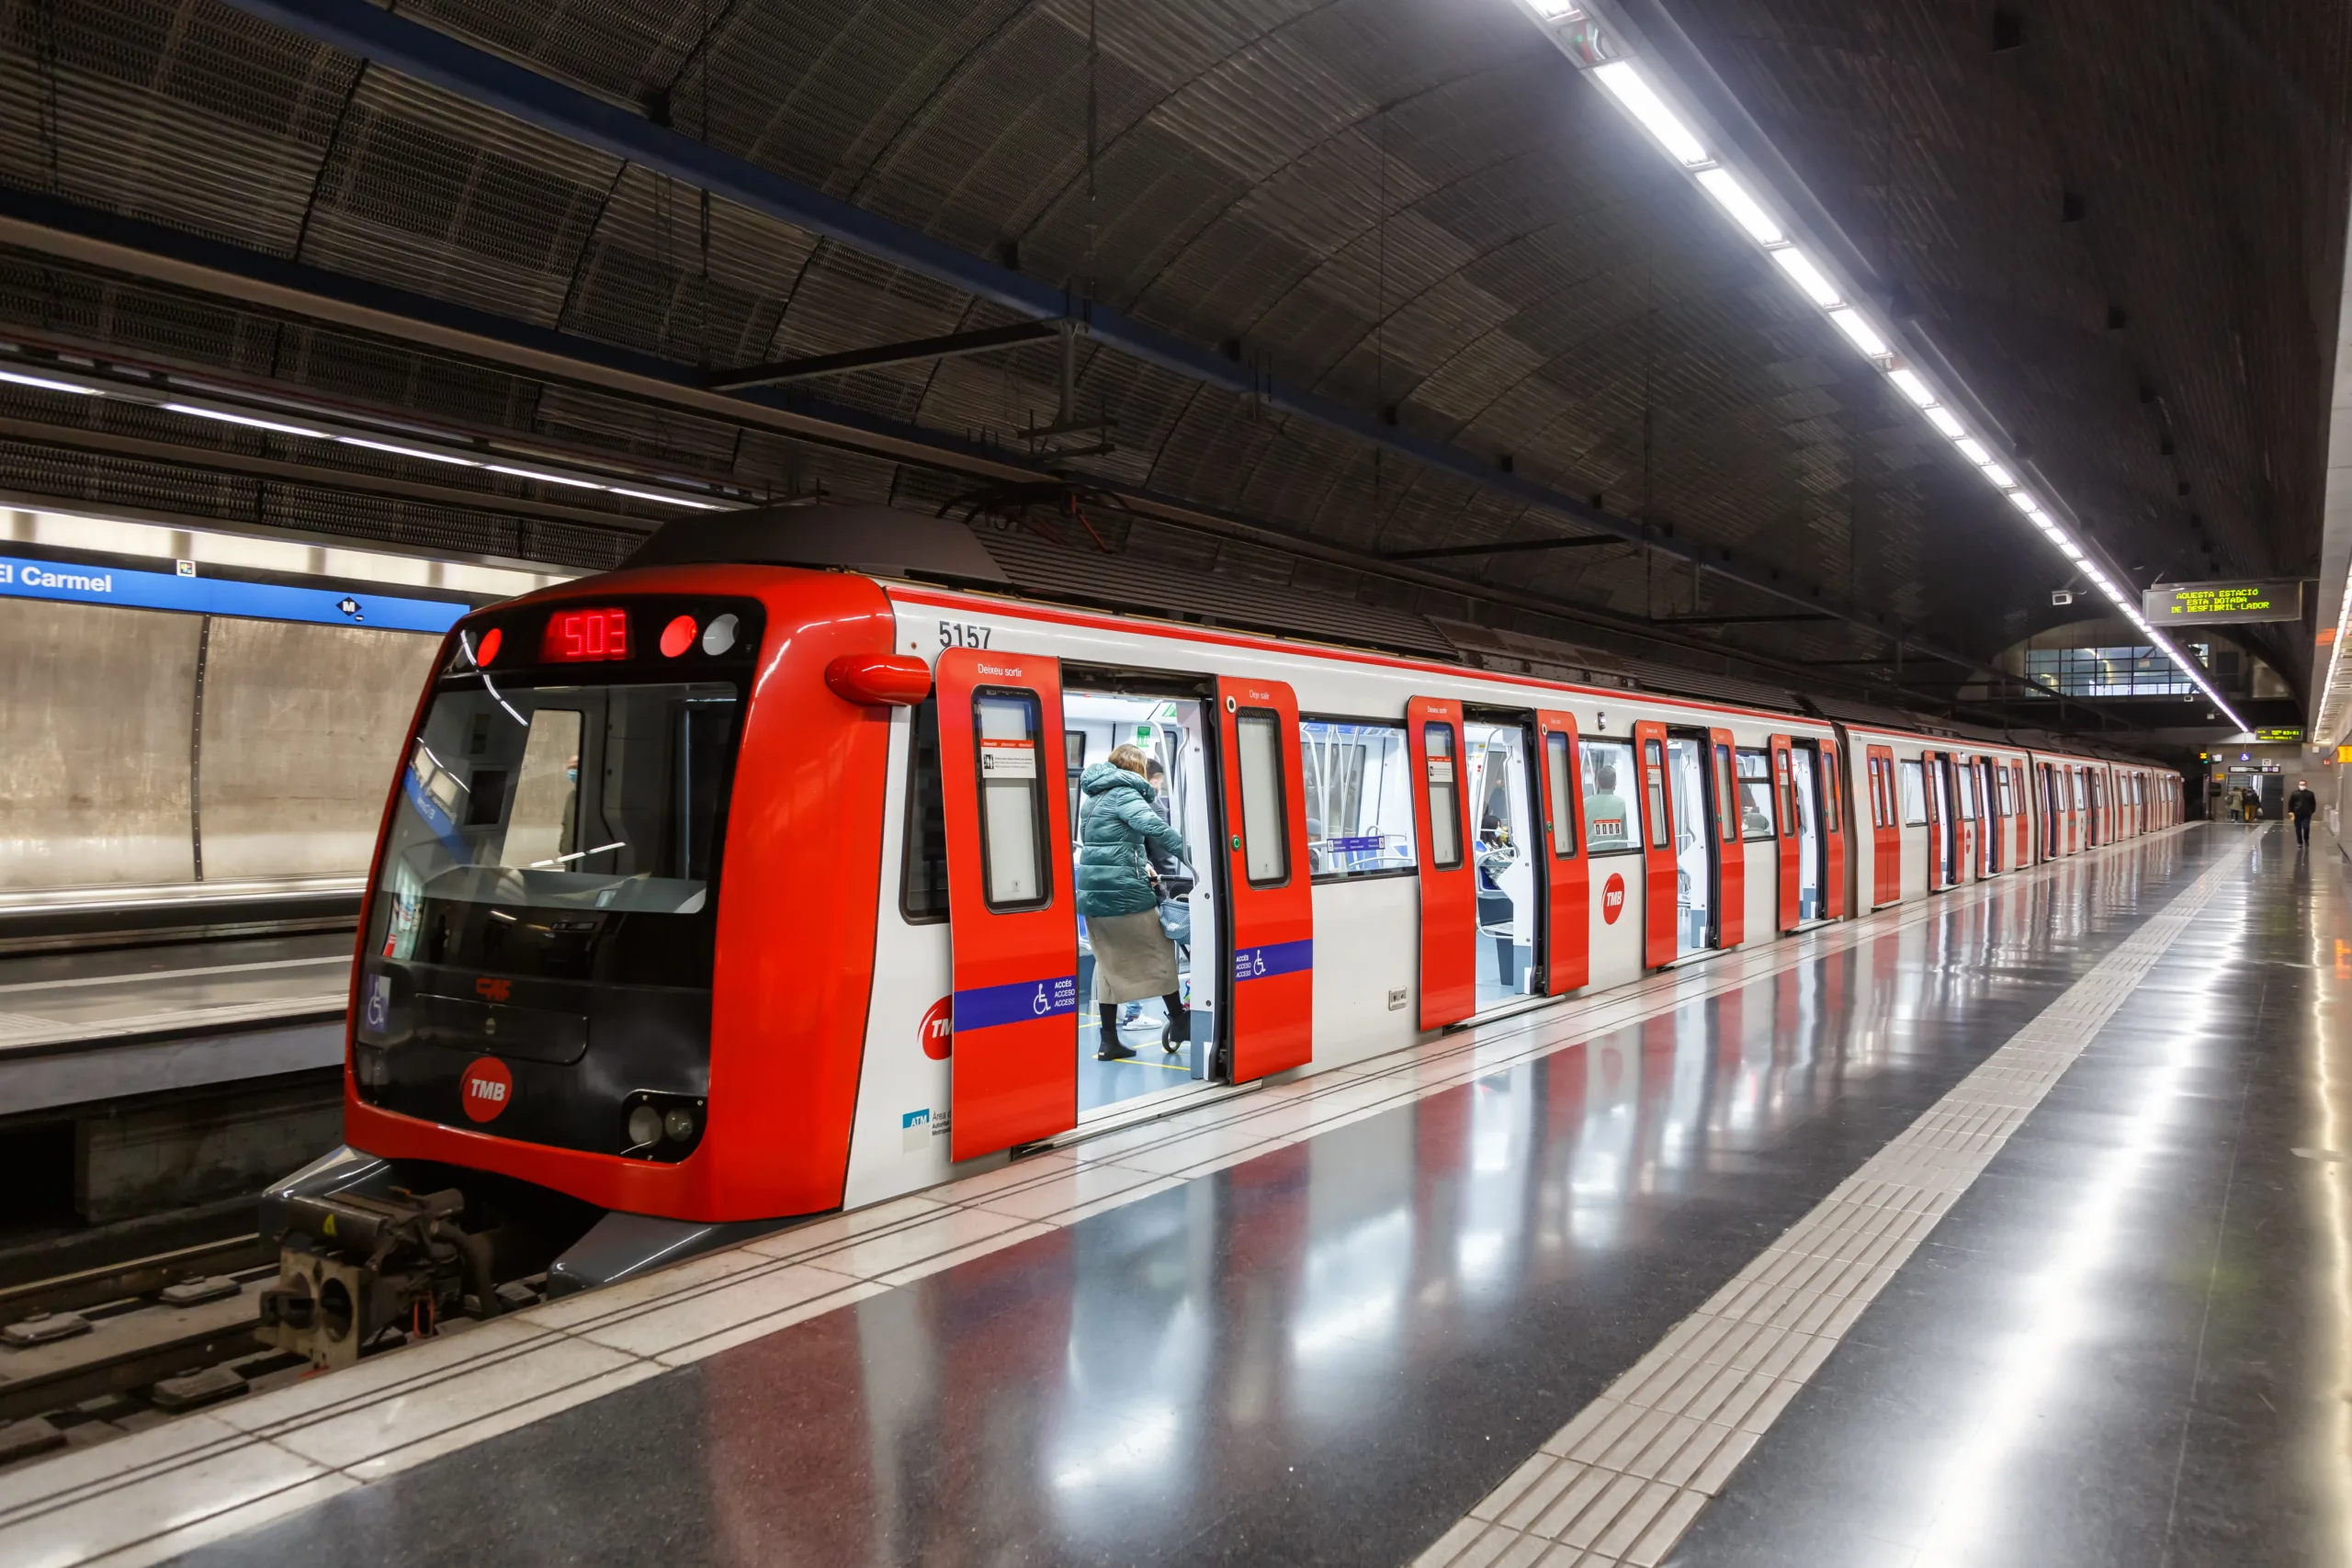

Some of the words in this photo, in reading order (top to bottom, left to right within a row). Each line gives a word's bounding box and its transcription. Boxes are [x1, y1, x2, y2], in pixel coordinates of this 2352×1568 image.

[20, 566, 112, 592] Carmel
[2176, 591, 2215, 600] AQUESTA
[2219, 588, 2259, 598] ESTACIÓ
[2213, 596, 2247, 604] DOTADA
[343, 601, 356, 613] M
[2170, 605, 2183, 614] DE
[565, 614, 627, 656] 503
[939, 620, 991, 649] 5157
[978, 663, 1003, 676] Deixeu
[1004, 667, 1023, 678] sortir
[1606, 890, 1623, 908] TMB
[1054, 979, 1072, 989] ACCÉS
[1054, 988, 1076, 998] ACCESO
[1054, 998, 1075, 1008] ACCESS
[932, 1018, 953, 1039] TM
[471, 1078, 506, 1101] TMB
[910, 1114, 927, 1127] ATM
